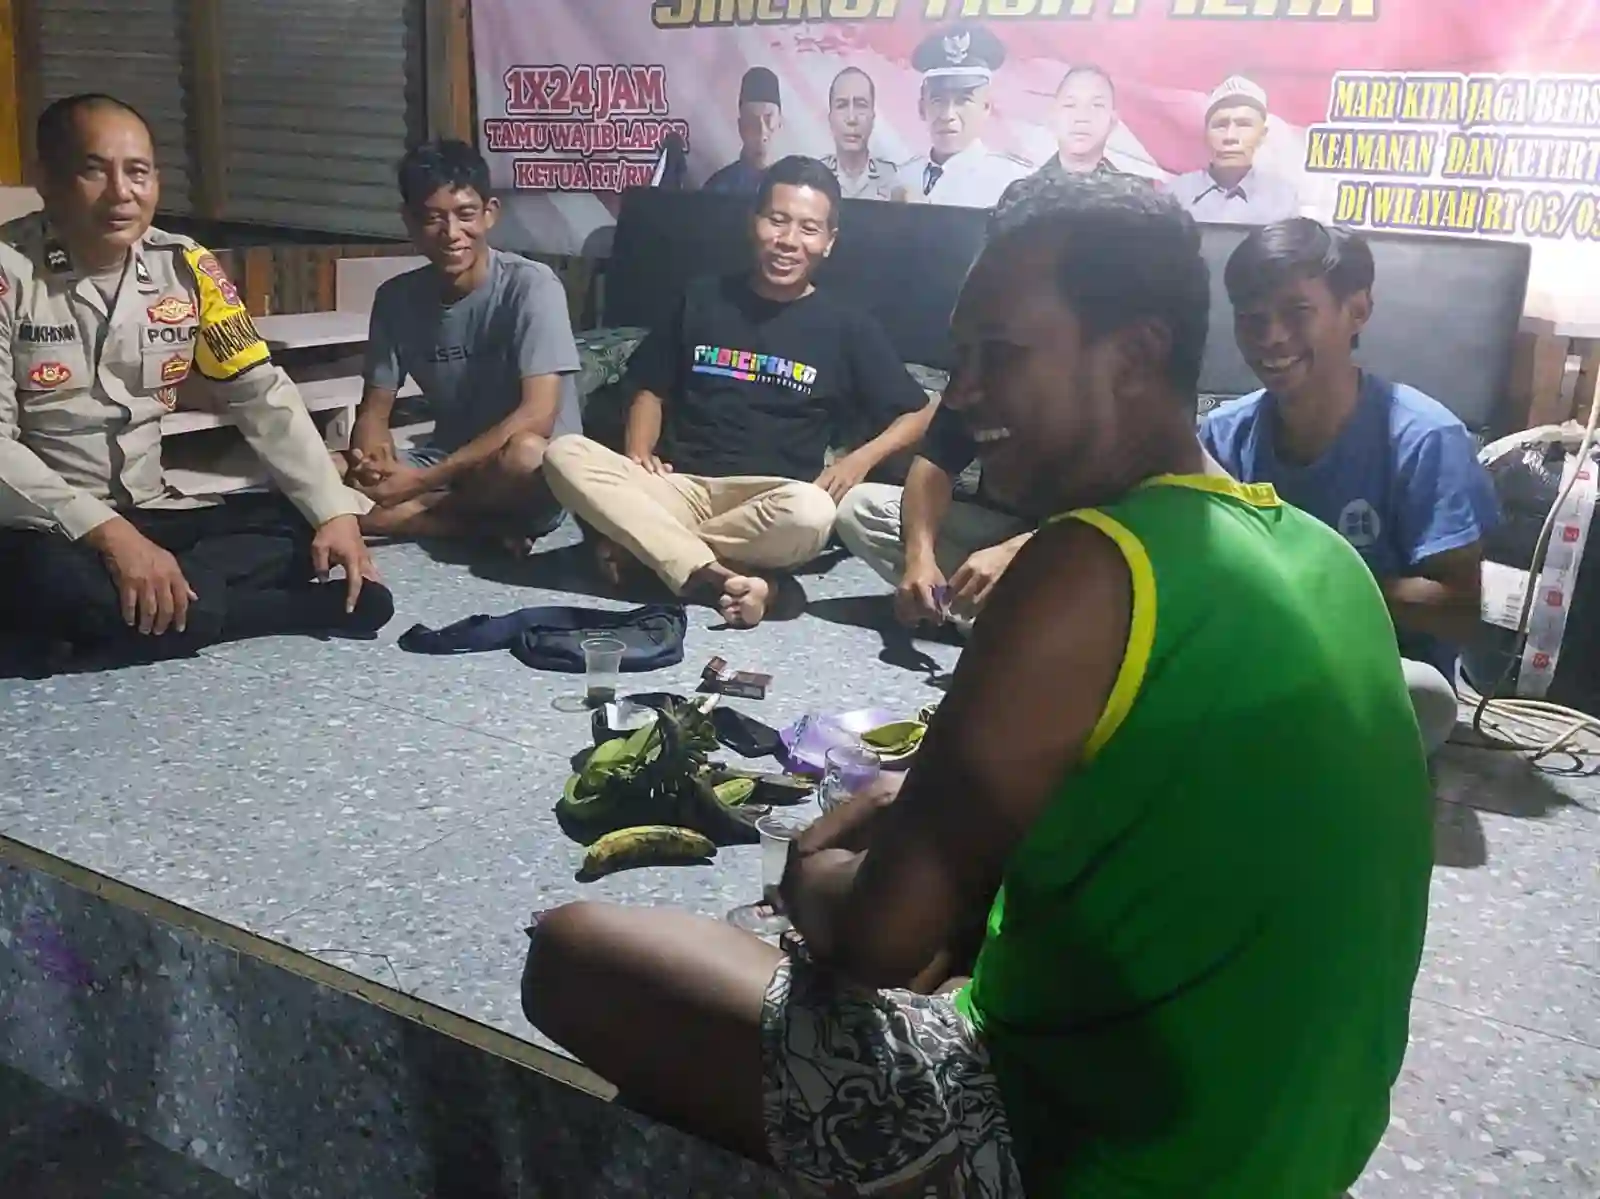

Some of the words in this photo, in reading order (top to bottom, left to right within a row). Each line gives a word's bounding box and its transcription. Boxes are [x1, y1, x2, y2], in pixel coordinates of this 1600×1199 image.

[506, 67, 595, 113] 1X24
[595, 67, 667, 120] JAM
[1335, 79, 1397, 120] MARI
[1400, 79, 1463, 121] KITA
[1464, 80, 1527, 125] JAGA
[487, 122, 549, 150] TAMU
[551, 122, 616, 155] WAJIB
[1307, 131, 1436, 175] KEAMANAN
[1443, 135, 1496, 176] DAN
[516, 161, 589, 190] KETUA
[1336, 184, 1367, 222] DI
[1372, 185, 1480, 230] WILAYAH
[1481, 189, 1521, 232] RT
